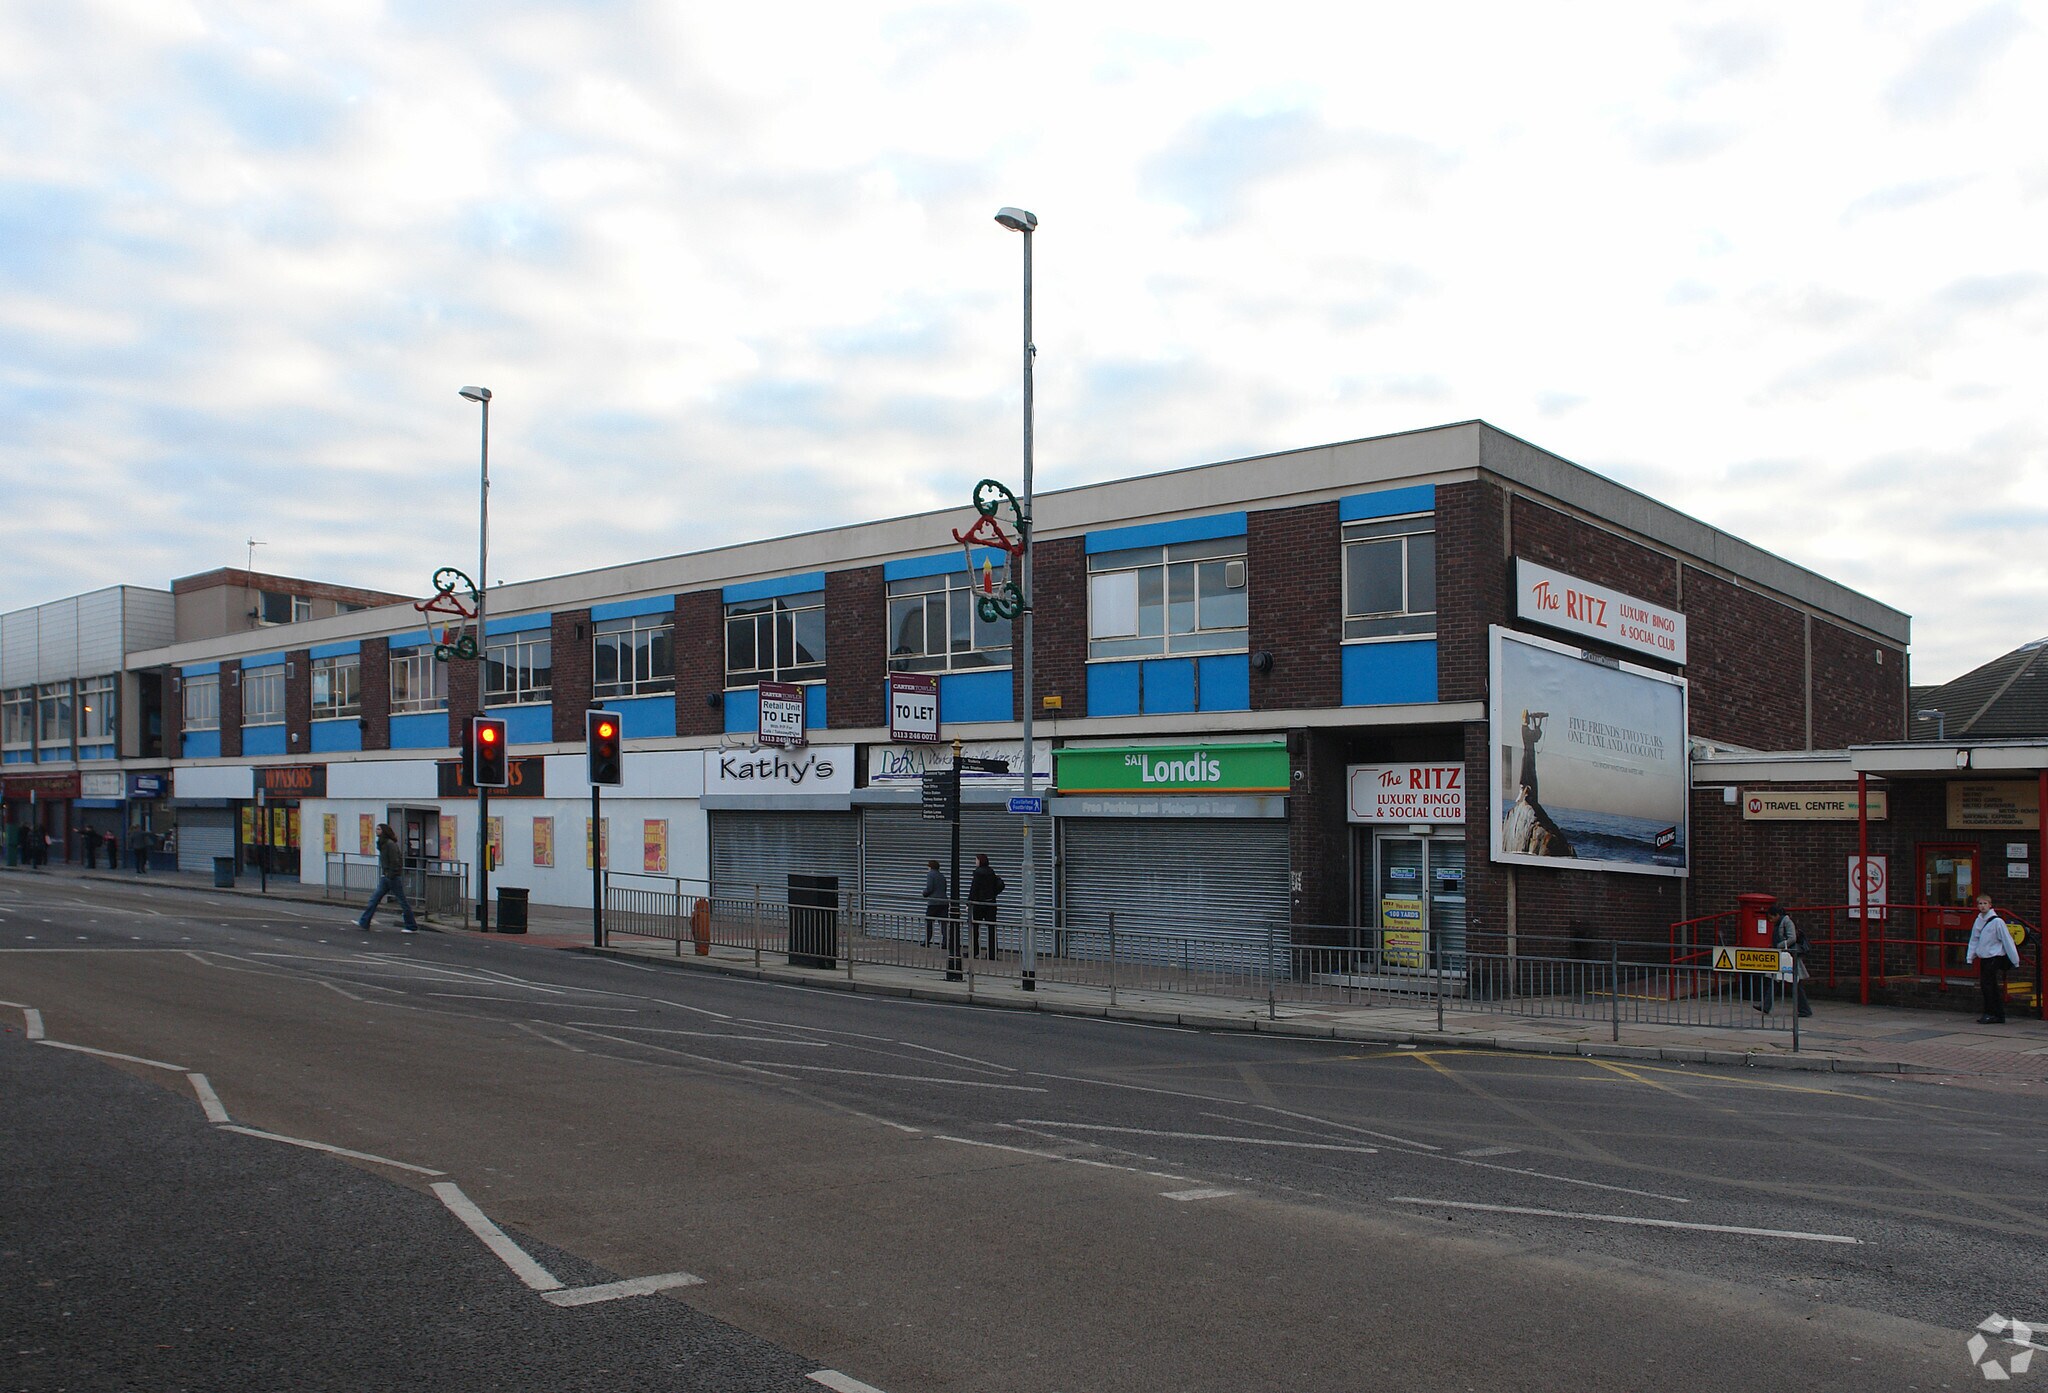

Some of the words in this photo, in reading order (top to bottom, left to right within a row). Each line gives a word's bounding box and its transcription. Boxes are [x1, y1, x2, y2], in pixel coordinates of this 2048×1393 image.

[1532, 581, 1560, 610] The
[1566, 589, 1608, 628] RITZ
[1619, 604, 1649, 624] LUXURY
[1652, 615, 1675, 633] BINGO
[1620, 624, 1627, 636] &
[1629, 627, 1655, 645] SOCIAL
[1657, 635, 1676, 651] CLUB
[763, 701, 784, 710] Retail
[785, 703, 801, 712] Unit
[896, 705, 910, 719] TO
[914, 706, 934, 720] LET
[763, 711, 777, 721] TO
[781, 713, 800, 723] LET
[1569, 717, 1589, 732] FIVE
[1621, 728, 1640, 742] TWO
[1567, 730, 1584, 745] ONE
[1607, 737, 1623, 752] AND
[1624, 741, 1629, 753] A
[720, 754, 835, 785] Kathy's
[1124, 755, 1142, 766] SAI
[1142, 751, 1221, 783] Londis
[266, 768, 312, 788] WYNSORS
[1378, 770, 1403, 788] The
[1409, 768, 1461, 789] RITZ
[1377, 794, 1418, 805] LUXURY
[1423, 793, 1460, 805] BINGO
[1764, 801, 1801, 811] TRAVEL
[1805, 801, 1845, 811] CENTRE
[1376, 807, 1384, 818] &
[1389, 807, 1428, 818] SOCIAL
[1433, 807, 1461, 818] CLUB
[1400, 910, 1419, 918] YARDS
[1740, 953, 1776, 963] DANGER
